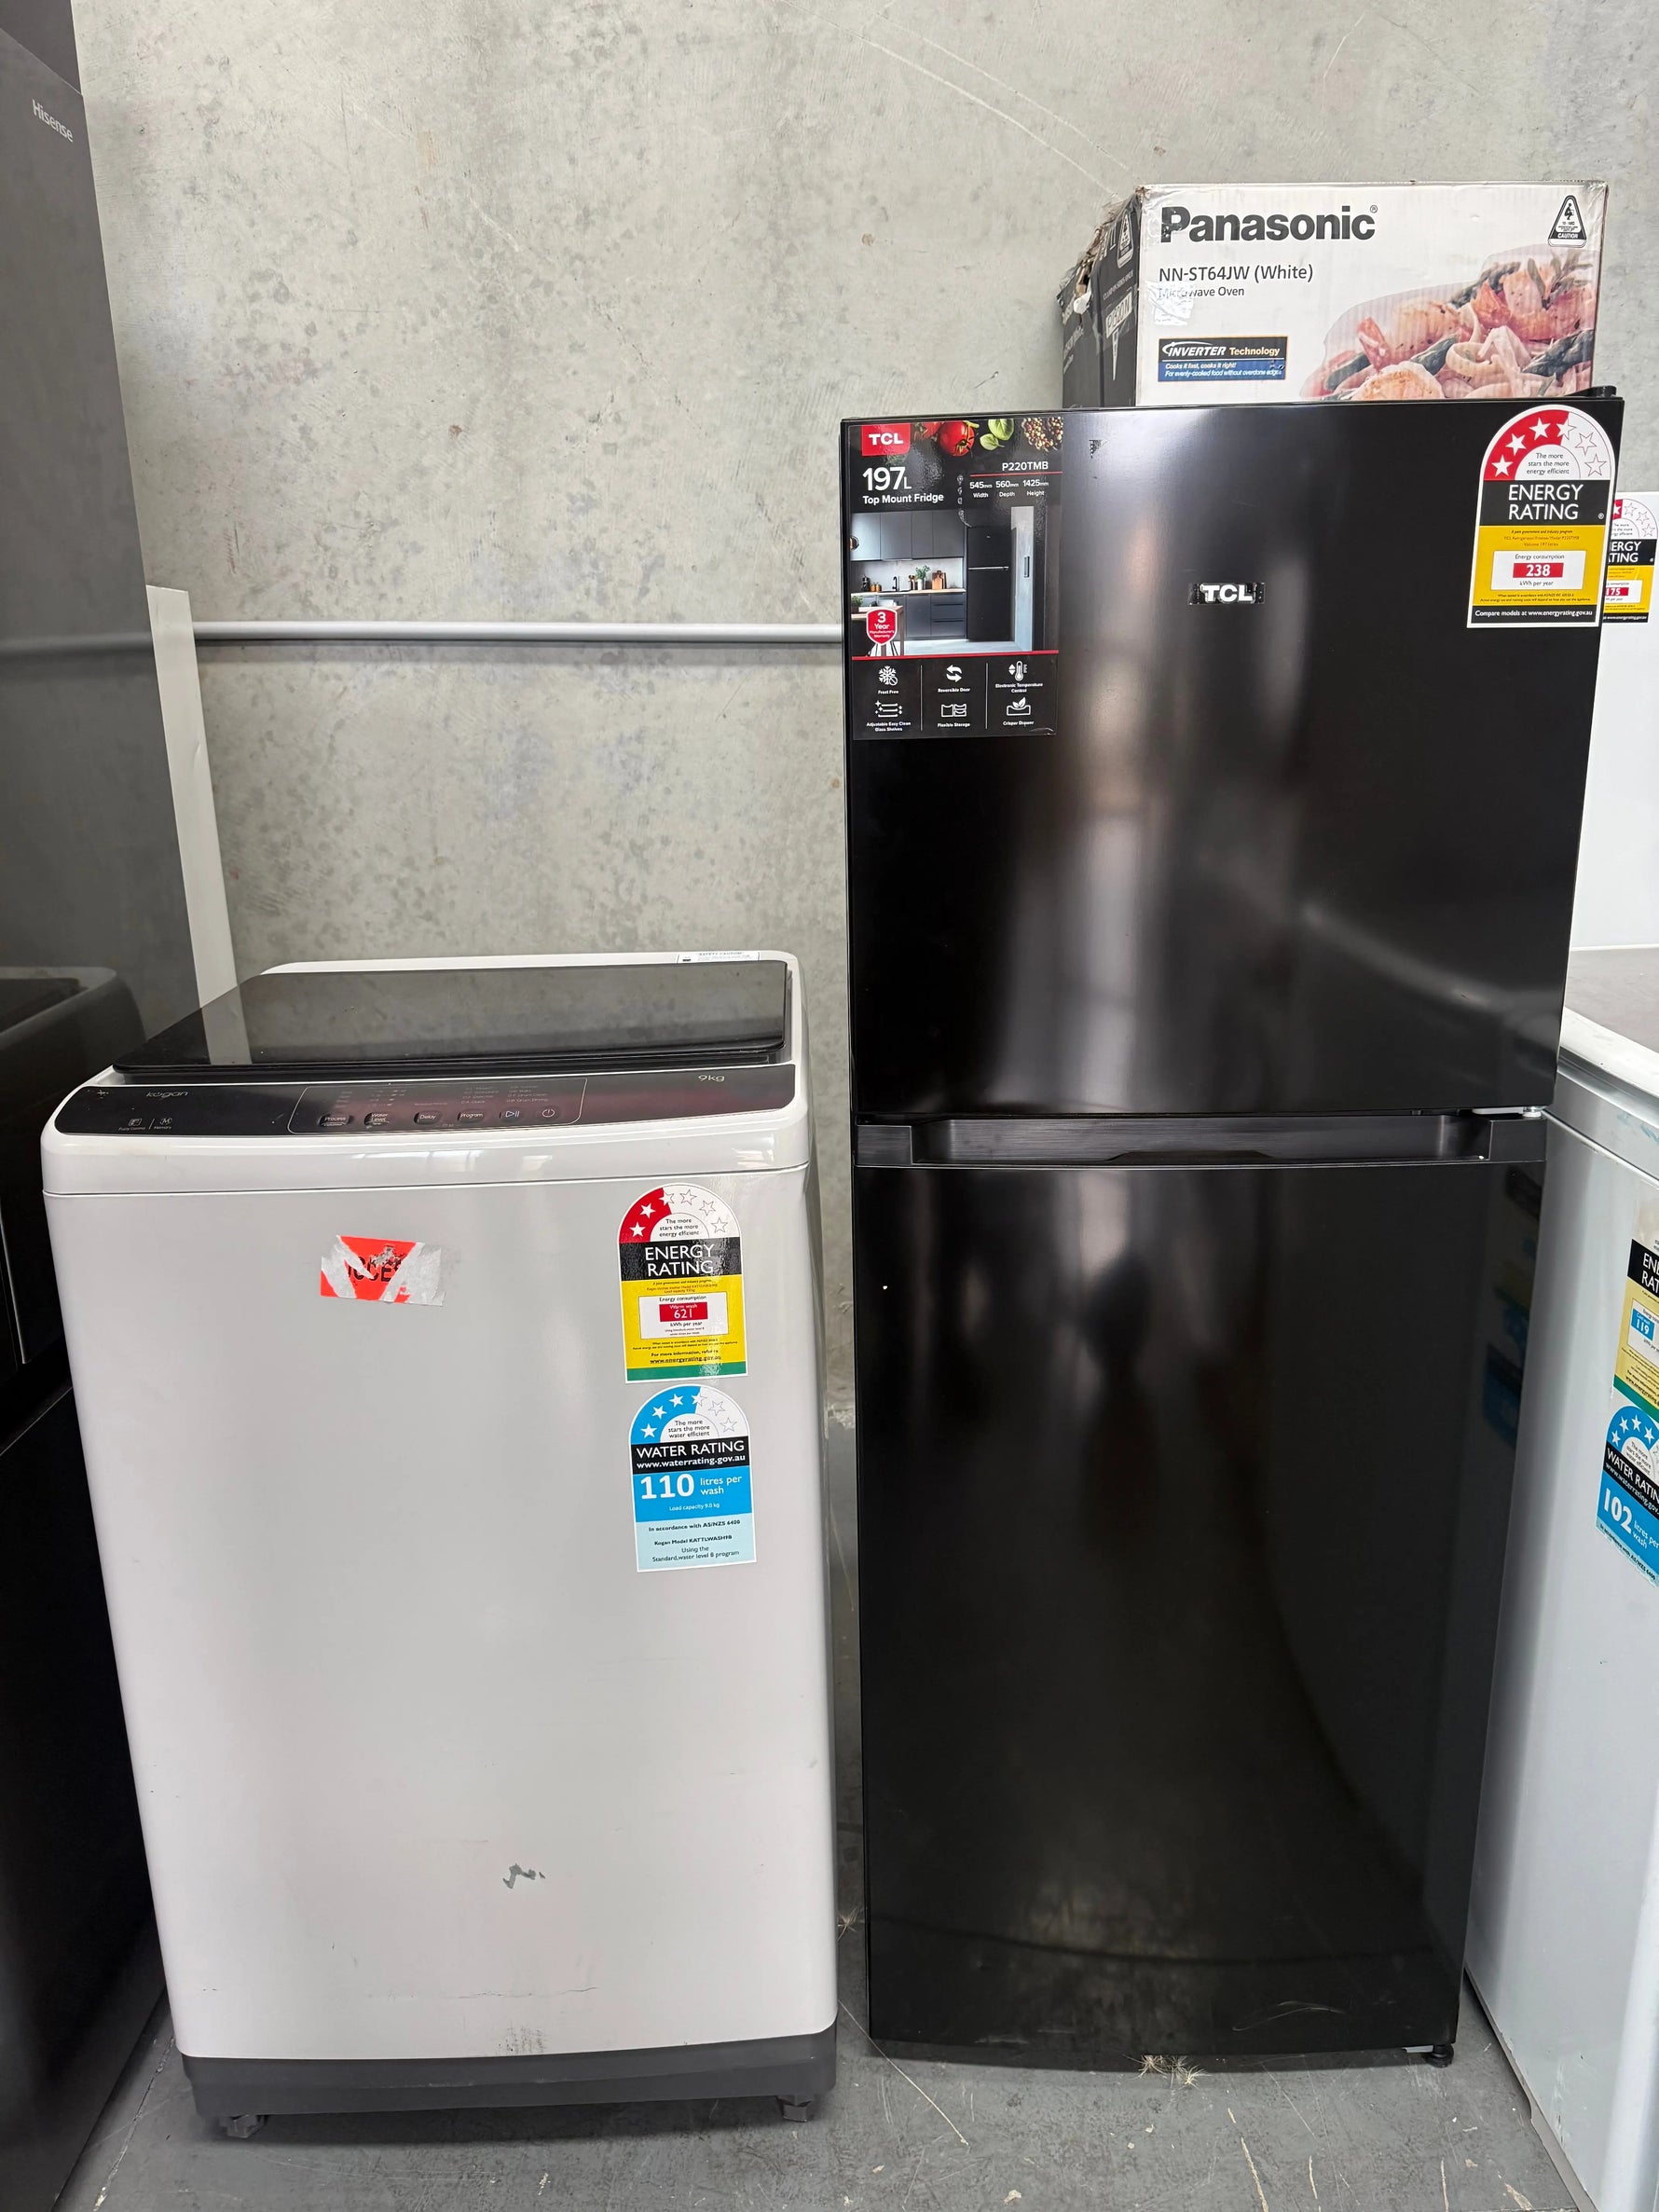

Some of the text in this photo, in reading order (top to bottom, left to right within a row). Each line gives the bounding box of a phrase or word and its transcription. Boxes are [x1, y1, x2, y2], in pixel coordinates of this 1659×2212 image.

[32, 99, 73, 142] Hisense
[1160, 205, 1376, 242] Panasonic
[1159, 264, 1313, 282] NN-ST64JW (White)
[1218, 286, 1244, 296] Oven
[1164, 344, 1280, 358] INVERTER Technology
[869, 433, 904, 446] TCL
[1002, 461, 1049, 471] P220TMB
[862, 467, 912, 491] 197L
[863, 493, 944, 505] Top Mount Fridge
[1508, 484, 1584, 501] ENERGY
[1508, 504, 1579, 520] RATING
[1526, 565, 1551, 577] 238
[1200, 584, 1254, 603] TCL
[877, 611, 885, 623] 3
[644, 1244, 714, 1261] ENERGY
[648, 1260, 714, 1276] RATING
[674, 1309, 692, 1319] 621
[1637, 1319, 1650, 1334] 119
[637, 1440, 745, 1459] WATER RATING
[637, 1454, 746, 1469] www.waterrating.gov.au
[1607, 1448, 1633, 1481] WATER
[640, 1474, 694, 1500] 110
[700, 1477, 742, 1486] litres per
[701, 1487, 724, 1496] wash
[1604, 1488, 1632, 1534] 102
[1634, 1519, 1648, 1539] litres
[1633, 1532, 1647, 1549] wash
